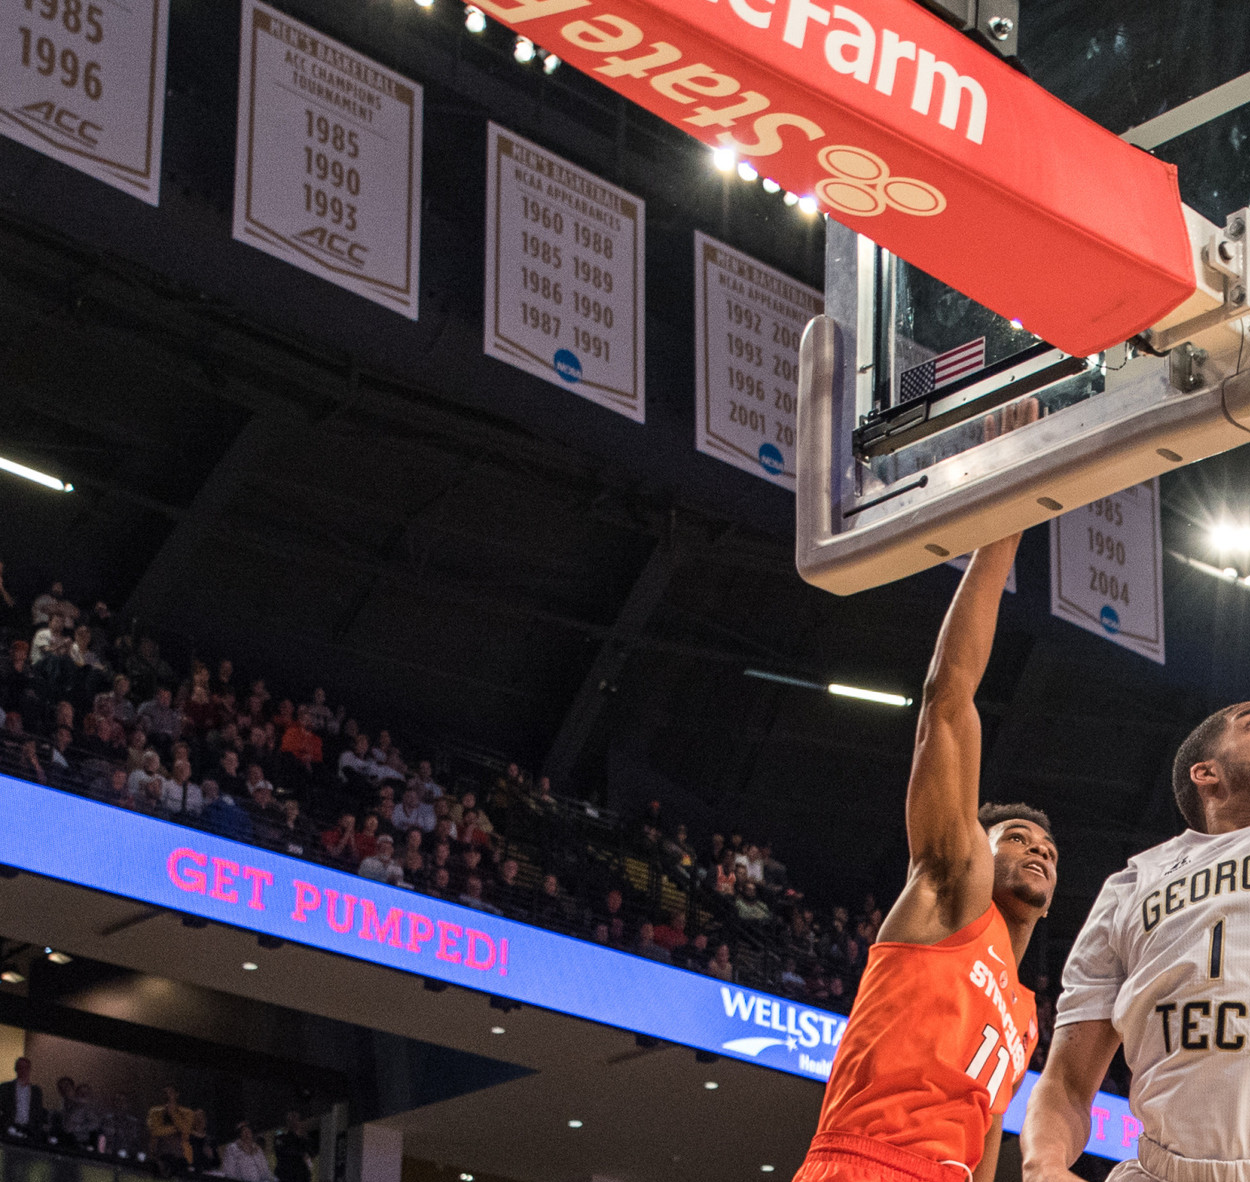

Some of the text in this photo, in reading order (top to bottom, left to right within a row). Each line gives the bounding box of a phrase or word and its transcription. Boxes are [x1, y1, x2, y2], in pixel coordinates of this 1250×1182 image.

[23, 0, 104, 44] 985
[19, 26, 103, 101] 1996
[22, 101, 104, 146] ACC
[305, 108, 360, 159] 1985
[304, 146, 361, 197] 1990
[303, 183, 358, 232] 1993
[521, 196, 614, 260] 1960 1988
[298, 226, 369, 266] ACC
[521, 231, 614, 294] 1985 1989
[521, 266, 614, 329] 1986 1990
[521, 302, 611, 364] 1987 1991
[726, 300, 800, 353] 1992 200
[727, 332, 799, 385] 1993 200
[728, 366, 765, 401] 1996
[729, 400, 766, 435] 2001
[1088, 527, 1126, 565] 1990
[1088, 566, 1130, 606] 2004
[166, 846, 510, 977] GET PUMPED!
[1207, 915, 1226, 982] 1
[720, 986, 849, 1048] WELLSTA
[965, 1023, 1011, 1110] 11
